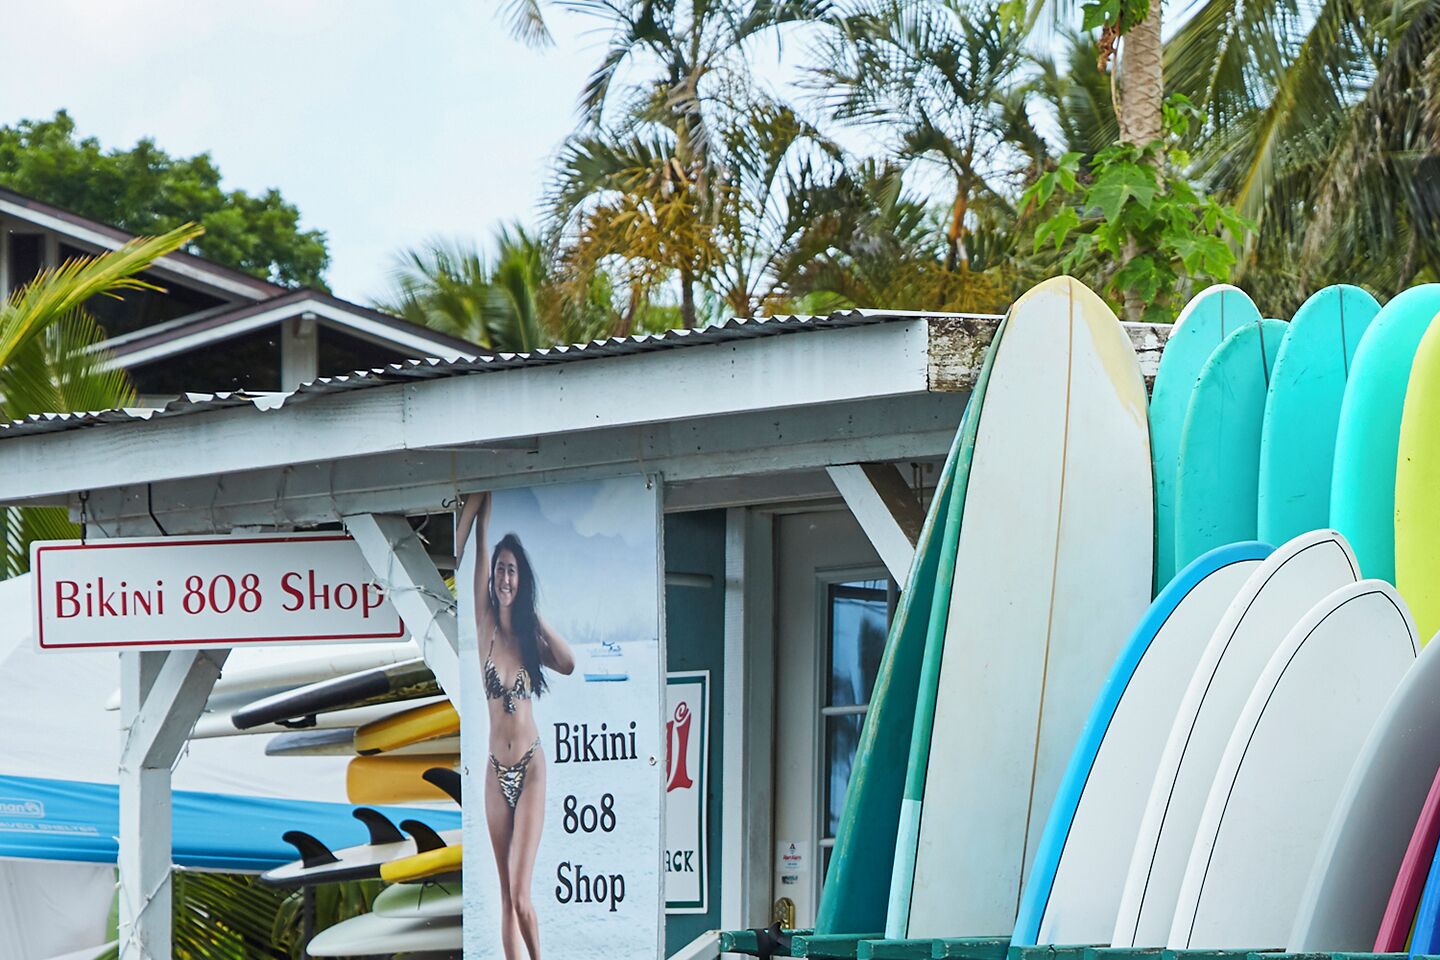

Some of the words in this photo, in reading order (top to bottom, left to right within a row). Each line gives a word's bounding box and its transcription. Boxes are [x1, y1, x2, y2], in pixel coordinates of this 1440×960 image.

[55, 576, 164, 618] Bikini
[182, 573, 263, 615] 808
[281, 569, 385, 618] Shop
[553, 721, 638, 764] Bikini
[562, 793, 617, 834] 808
[554, 861, 626, 912] Shop
